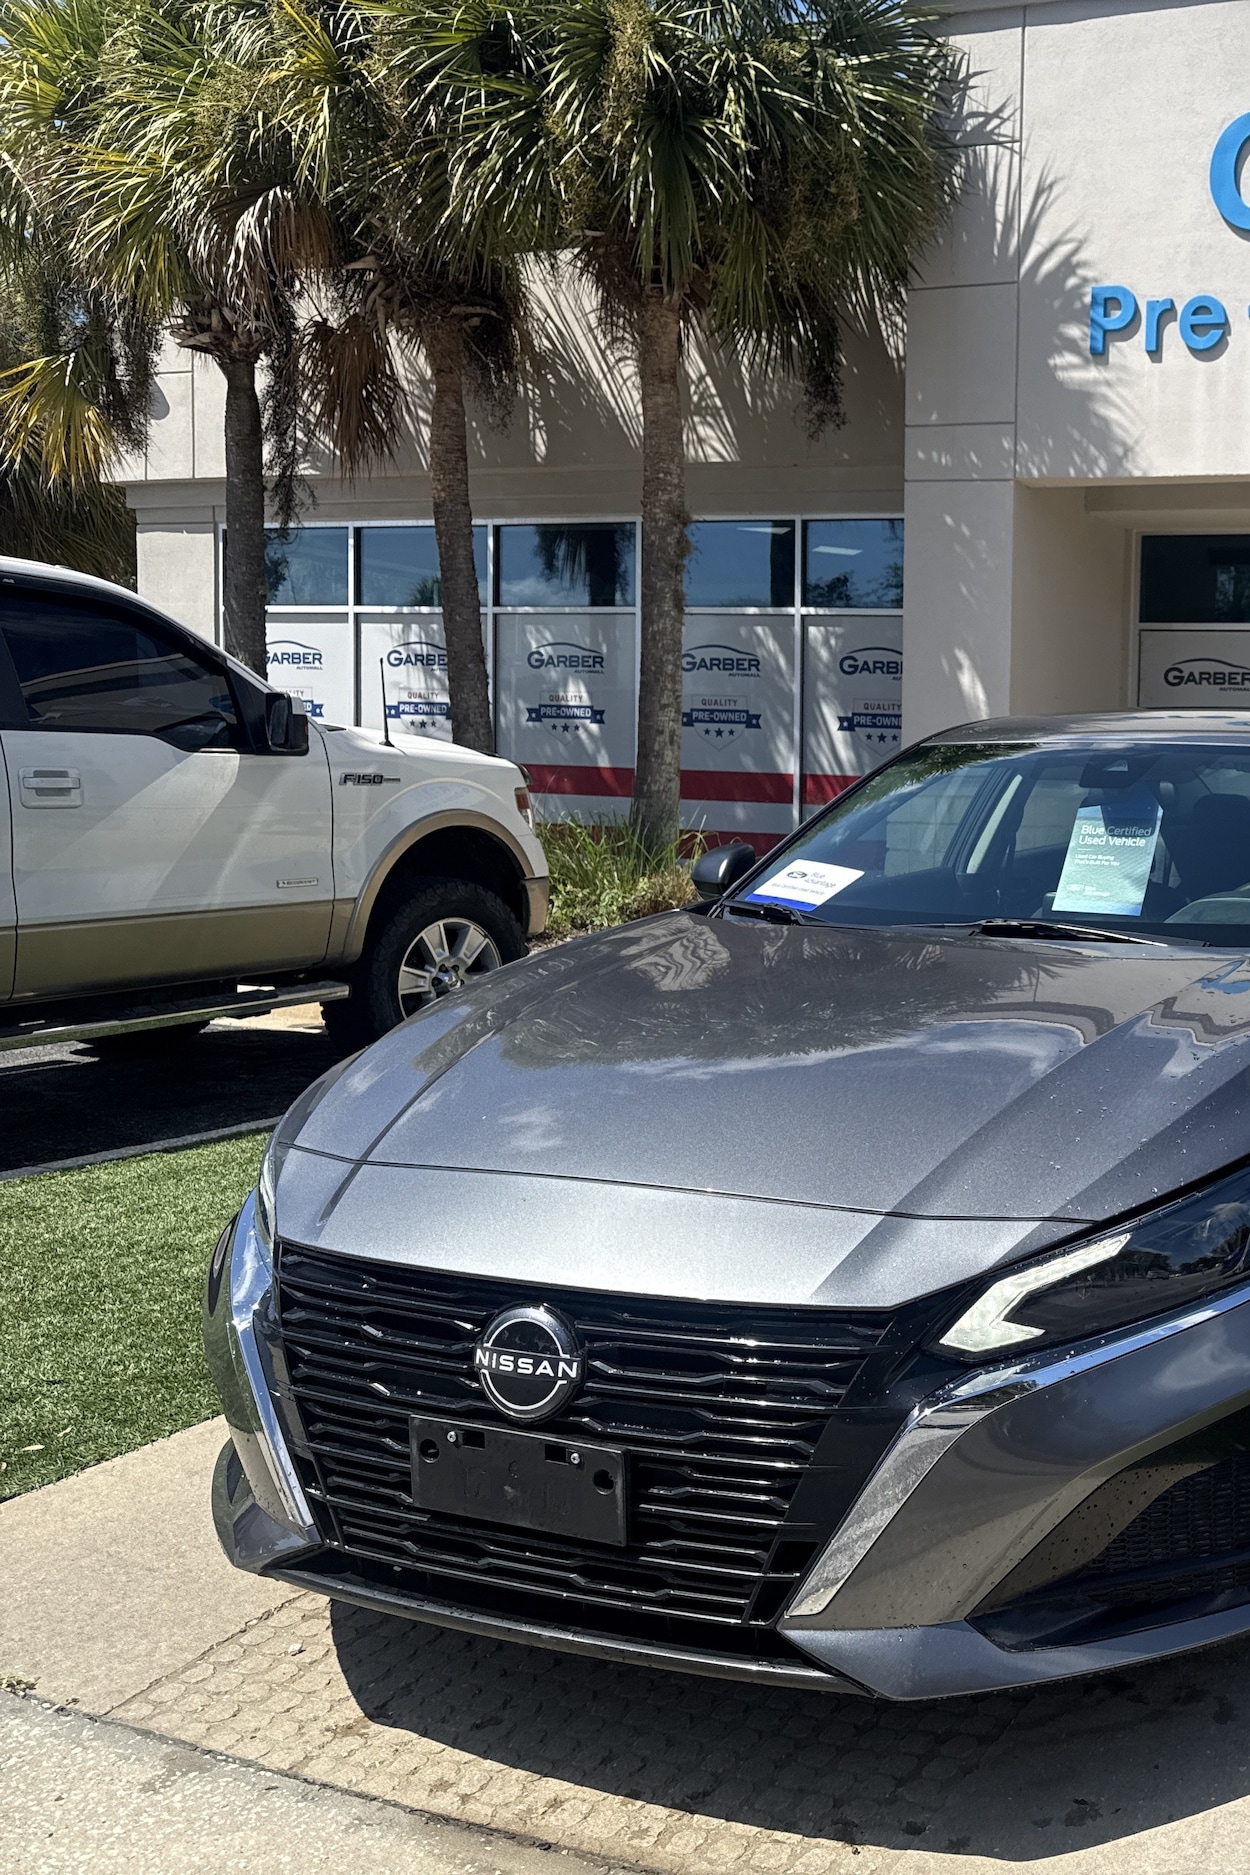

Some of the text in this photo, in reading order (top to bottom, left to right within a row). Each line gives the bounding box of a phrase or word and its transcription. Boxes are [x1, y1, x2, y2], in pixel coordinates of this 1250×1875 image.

[386, 650, 448, 667] GARBE
[527, 651, 605, 669] GARBER
[681, 653, 761, 672] GARBER
[839, 656, 903, 675] GARB
[407, 691, 440, 700] QUALITY
[548, 694, 584, 703] QUALITY
[399, 703, 447, 714] PRE-OWNED
[701, 698, 738, 707] QUALITY
[863, 702, 902, 711] QUALITY
[540, 706, 592, 718] PRE-OWNED
[692, 711, 747, 722] PRE-OWNED
[853, 715, 902, 727] PRE-OWN
[1081, 824, 1153, 836] Blue Certified
[1079, 835, 1146, 847] Used Vehicle
[475, 1348, 578, 1378] NISSAN
